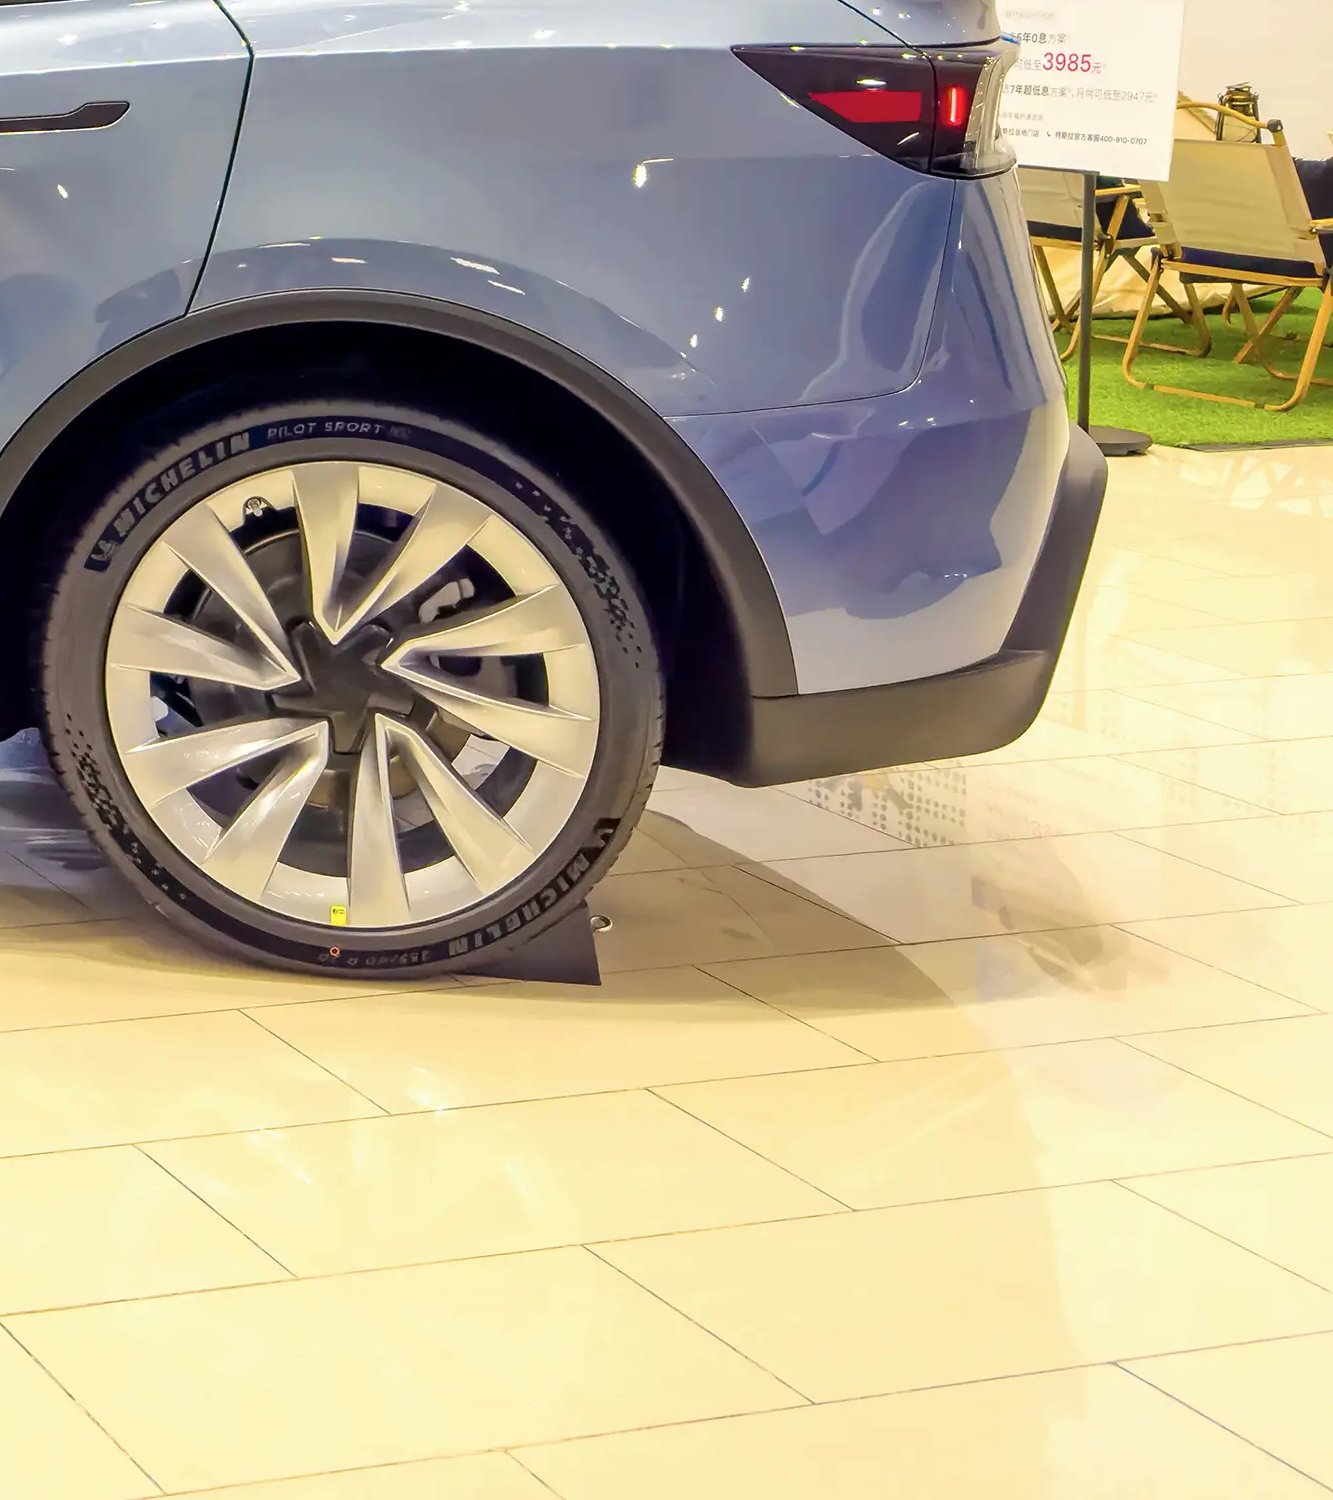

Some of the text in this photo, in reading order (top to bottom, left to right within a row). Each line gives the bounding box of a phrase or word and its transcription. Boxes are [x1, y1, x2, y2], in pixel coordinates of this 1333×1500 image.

[114, 430, 251, 538] MICHELIN
[267, 422, 317, 439] PILOT
[323, 421, 384, 435] SPORT
[448, 852, 591, 958] MICHELIN
